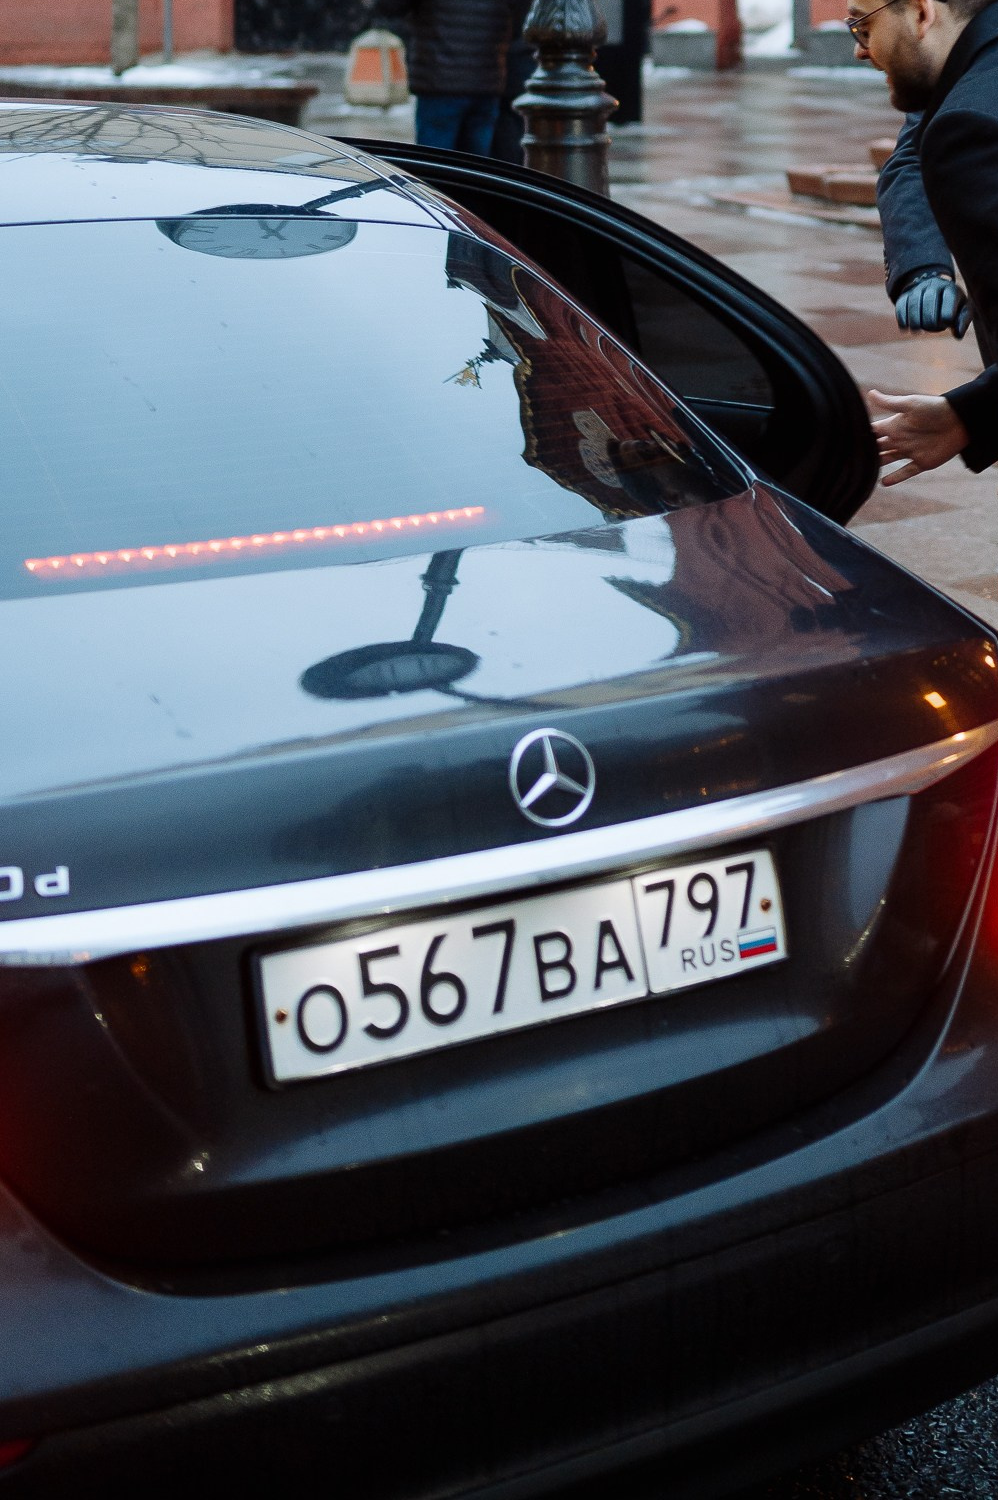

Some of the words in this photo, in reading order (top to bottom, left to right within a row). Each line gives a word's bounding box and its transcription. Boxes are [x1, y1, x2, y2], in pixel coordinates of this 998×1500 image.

[296, 917, 636, 1054] О567ВА
[644, 860, 756, 949] 797
[681, 938, 737, 972] RUS
